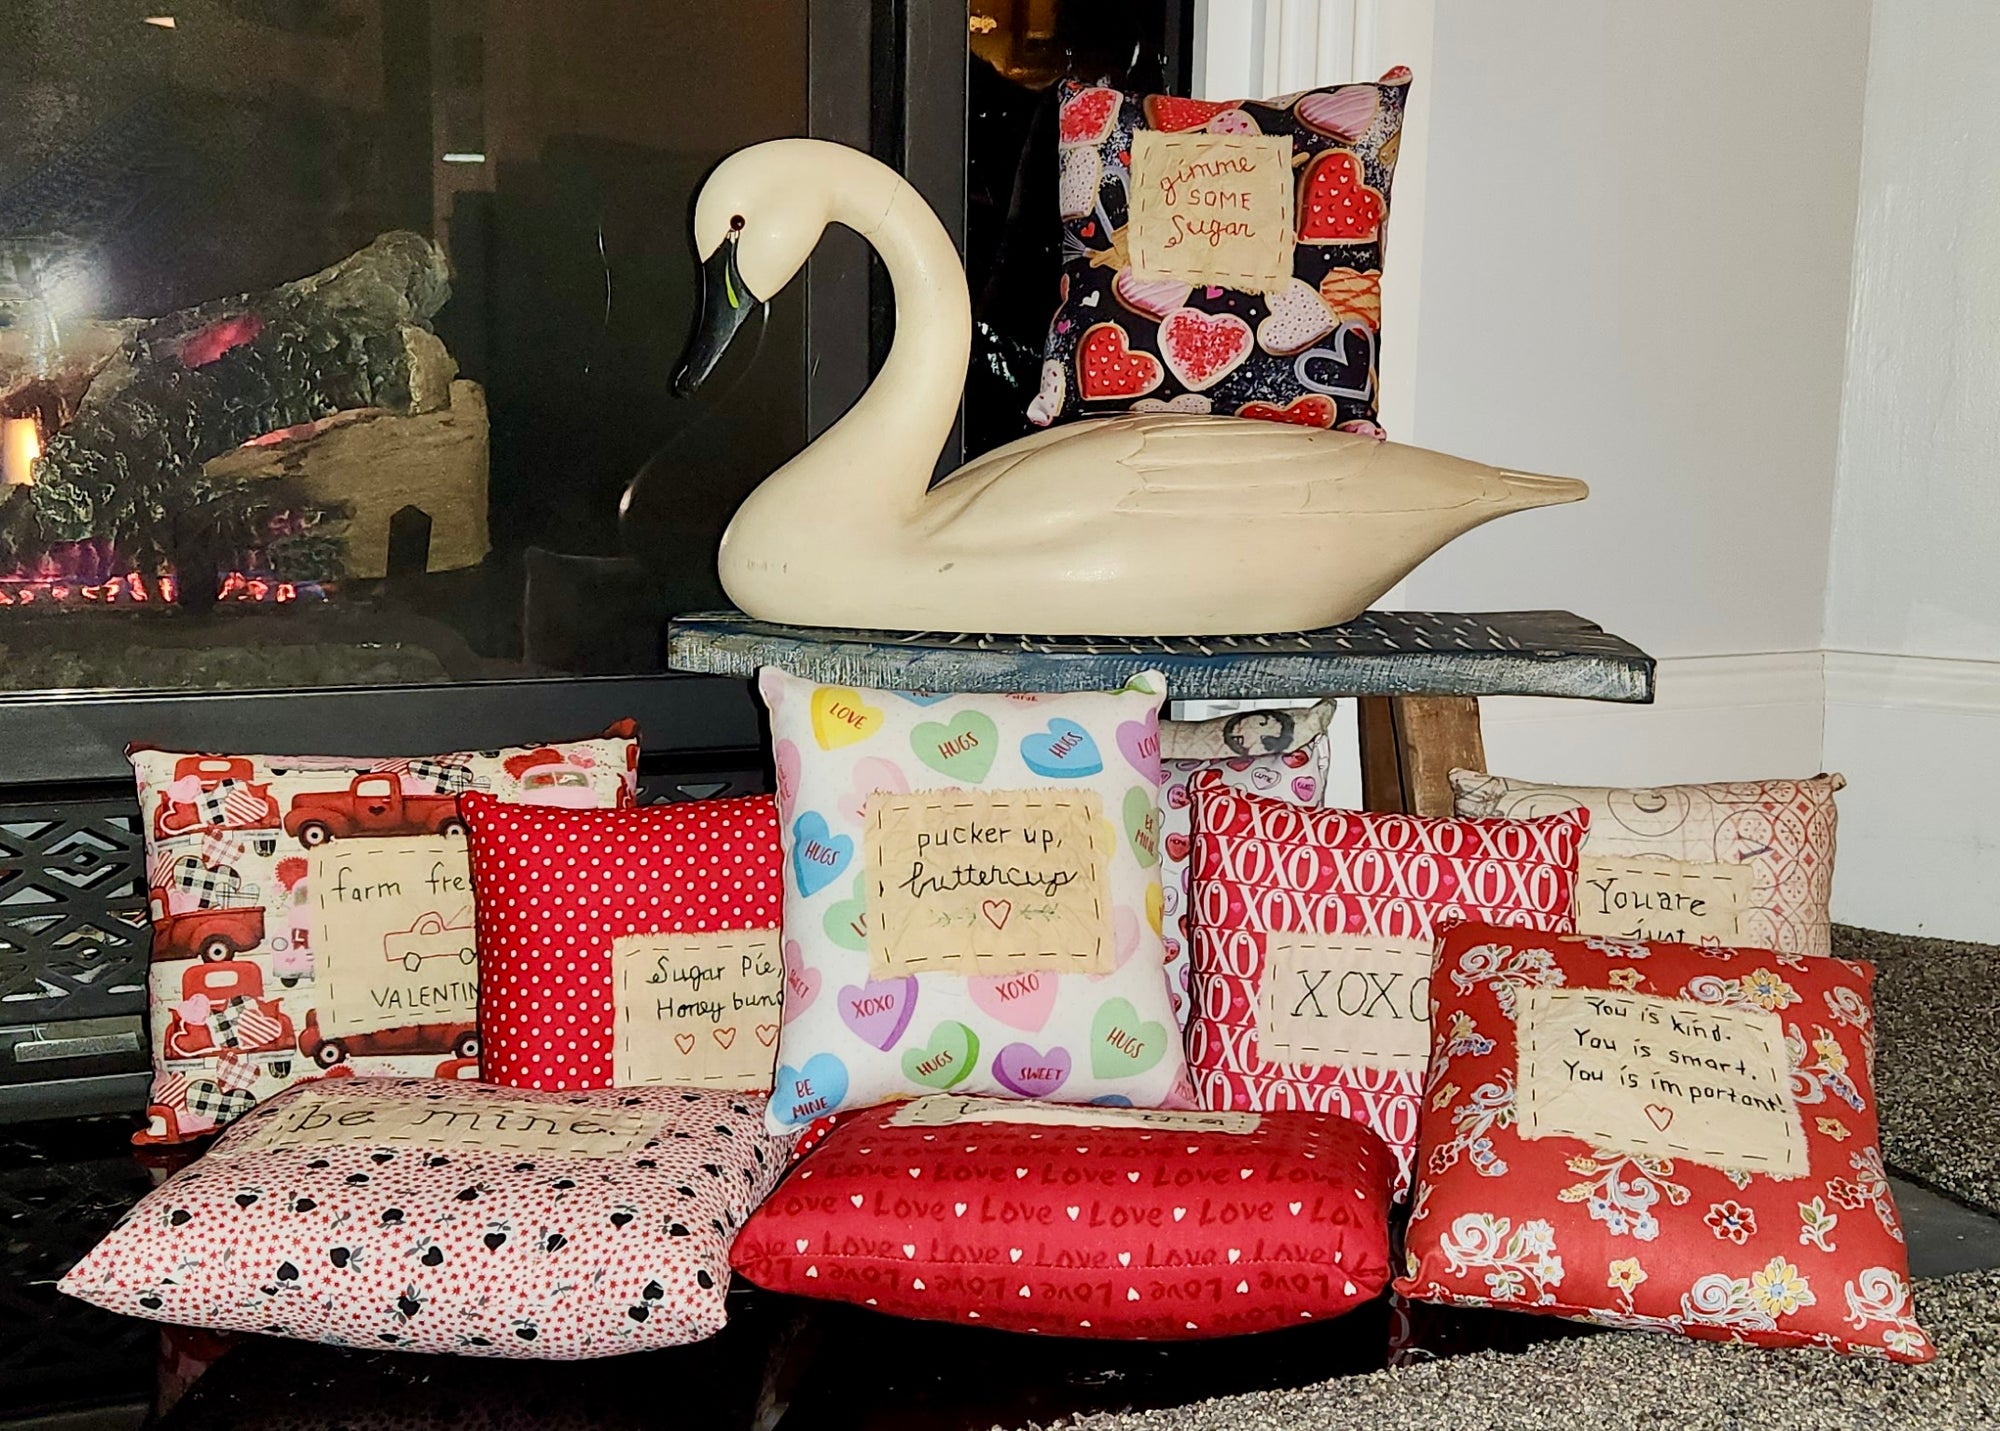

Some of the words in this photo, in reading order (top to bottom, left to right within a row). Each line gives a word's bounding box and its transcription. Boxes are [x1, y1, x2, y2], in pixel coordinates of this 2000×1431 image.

[1160, 155, 1256, 207] gimme
[1188, 189, 1253, 211] SOME
[1164, 214, 1256, 248] Sugar
[829, 702, 868, 731] LOVE
[938, 731, 980, 760] HUGS
[1049, 731, 1085, 760] HUGS
[917, 821, 1012, 858] pucker
[1024, 828, 1062, 853] up,
[1238, 802, 1347, 849] XOXO
[1353, 816, 1463, 857] XOXO
[1471, 823, 1573, 868] XOXO
[804, 839, 840, 866] HUGS
[331, 867, 402, 902] farm
[898, 861, 1078, 899] buttercup
[1211, 835, 1320, 892] XOXO
[1326, 848, 1439, 901] XOXO
[1447, 857, 1558, 913] XOXO
[1586, 878, 1654, 916] You
[645, 955, 726, 992] Sugar
[742, 953, 782, 978] Pie,
[995, 973, 1041, 1002] XOXO
[657, 997, 726, 1023] Honey
[851, 994, 895, 1019] XOXO
[1588, 1000, 1628, 1018] You
[1641, 1007, 1660, 1025] is
[1671, 1015, 1733, 1043] kind.
[1106, 1026, 1145, 1059] HUGS
[1573, 1028, 1617, 1052] You
[1633, 1038, 1651, 1058] is
[1669, 1048, 1758, 1081] smart.
[916, 1050, 954, 1077] HUGS
[1017, 1067, 1064, 1082] SWEET
[1563, 1059, 1604, 1083] You
[1620, 1065, 1638, 1089] is
[795, 1079, 815, 1099] BE
[289, 1104, 376, 1133] be
[411, 1108, 616, 1136] mine.
[792, 1097, 829, 1119] MINE
[934, 1162, 1005, 1183] Love
[1041, 1162, 1117, 1186] Love
[1153, 1166, 1229, 1188] Love
[765, 1196, 839, 1218] Love
[873, 1190, 946, 1221] Love
[980, 1195, 1053, 1225] Love
[1089, 1201, 1163, 1229] Love
[1199, 1199, 1274, 1227] Love
[1150, 1281, 1222, 1303] Love
[1259, 1271, 1329, 1300] Love
